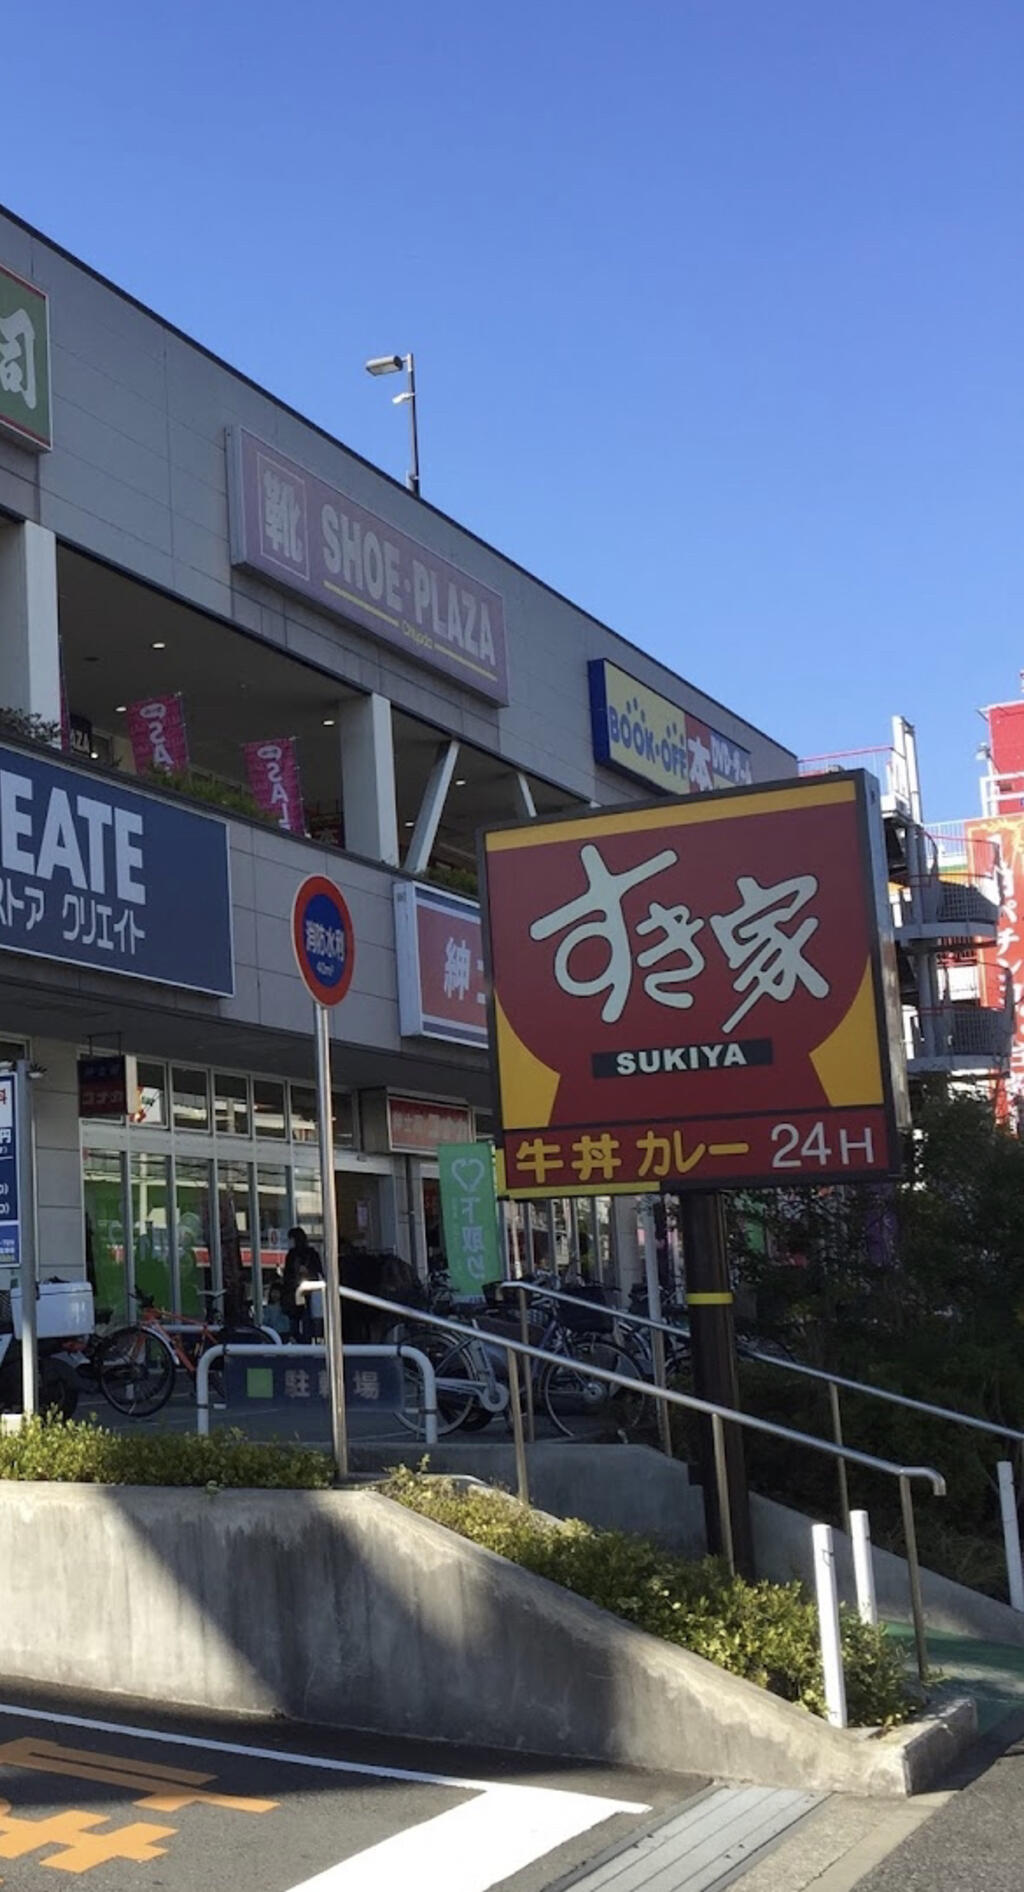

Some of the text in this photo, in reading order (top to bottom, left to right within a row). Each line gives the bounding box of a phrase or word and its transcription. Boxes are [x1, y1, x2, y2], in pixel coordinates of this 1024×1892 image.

[62, 893, 145, 955] クリエイト
[529, 843, 831, 1034] すき家
[616, 1042, 747, 1076] SUKIYA
[516, 1133, 621, 1184] 牛丼
[636, 1130, 750, 1177] カレー
